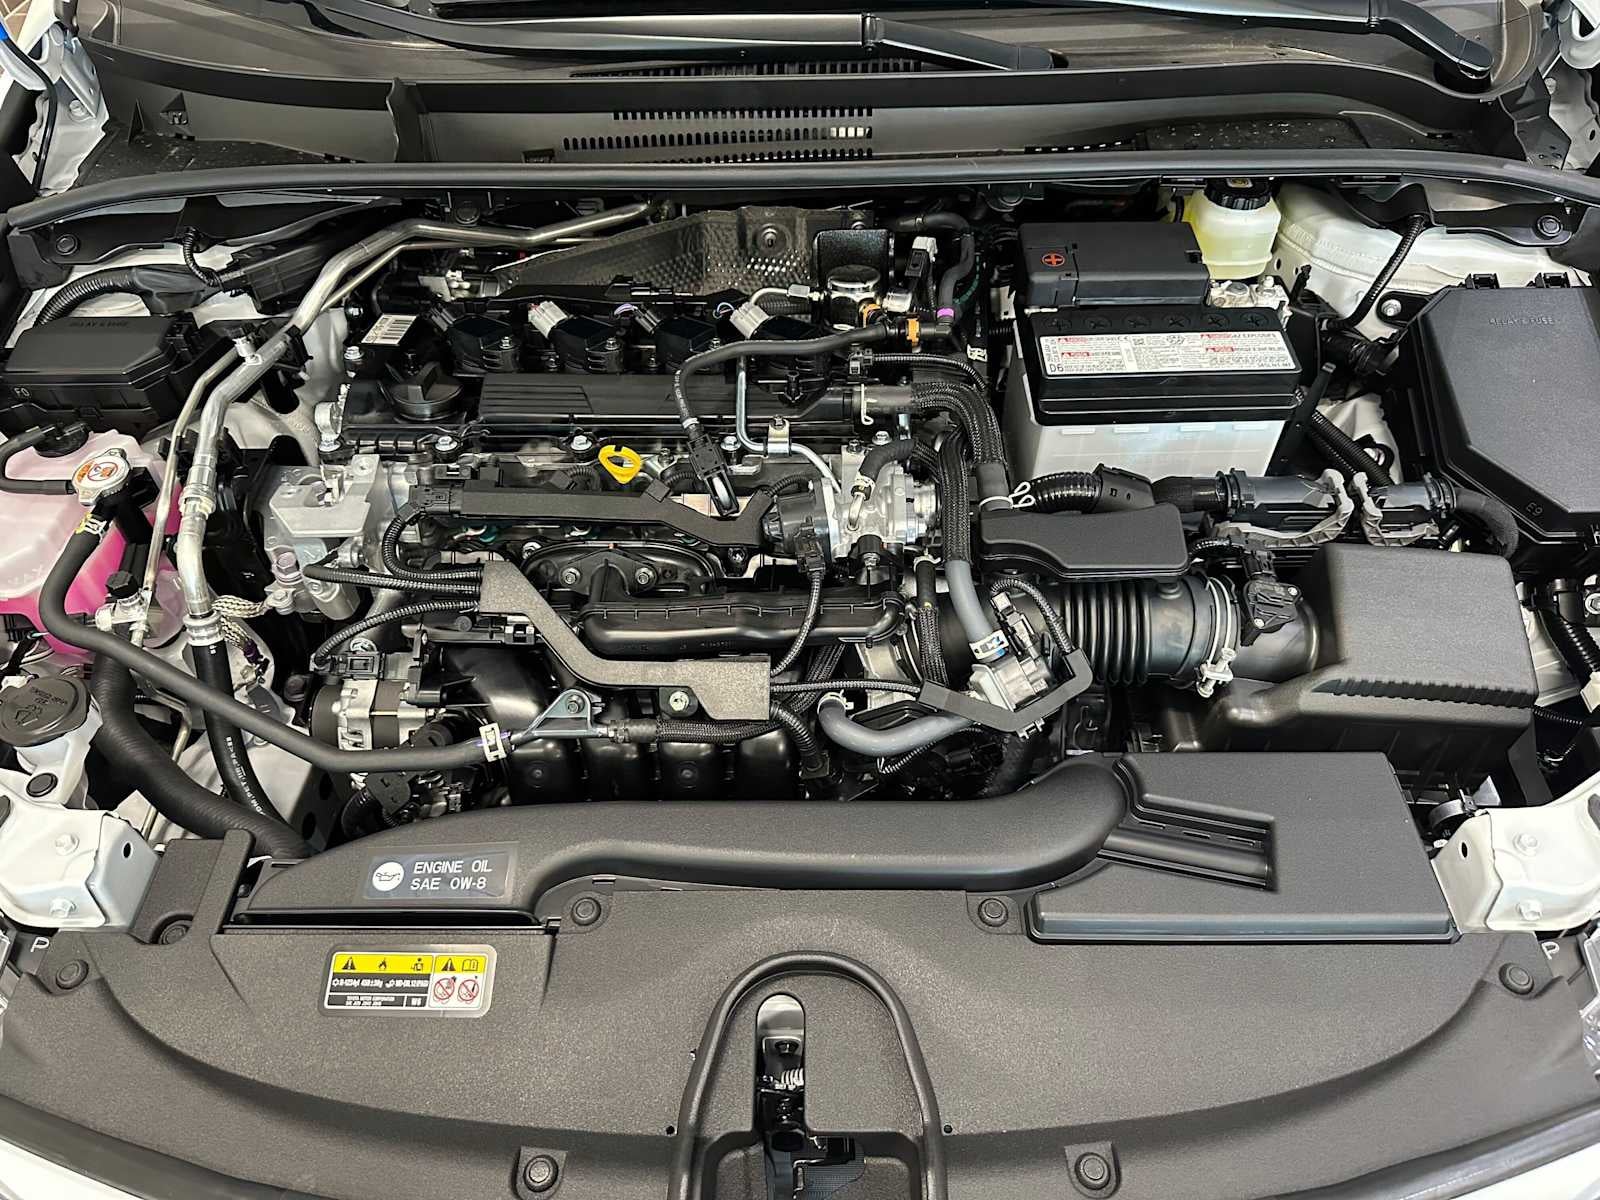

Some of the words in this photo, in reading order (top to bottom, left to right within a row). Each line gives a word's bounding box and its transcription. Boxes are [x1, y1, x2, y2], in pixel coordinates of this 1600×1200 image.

[413, 860, 464, 874] ENGINE
[471, 859, 493, 873] OIL
[410, 877, 442, 891] SAE
[450, 876, 487, 890] 0W-8
[30, 936, 50, 953] P
[1541, 941, 1560, 960] P
